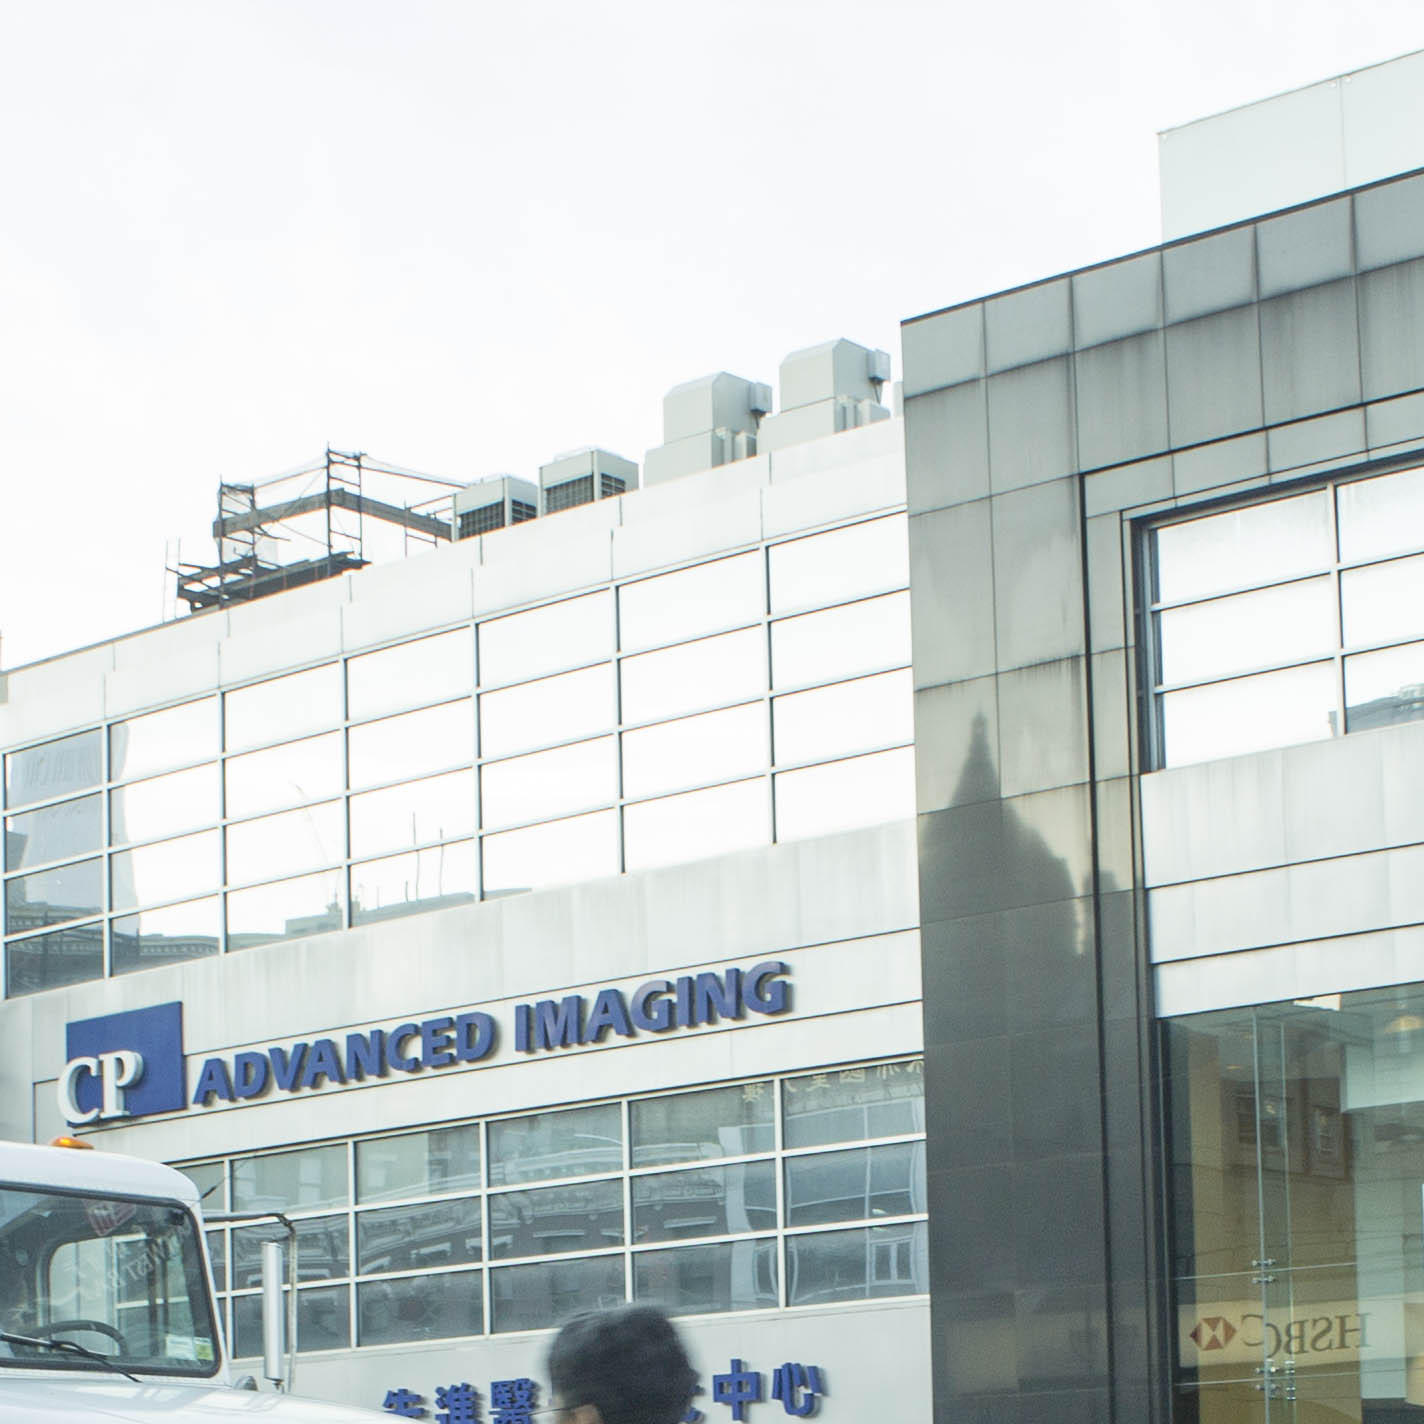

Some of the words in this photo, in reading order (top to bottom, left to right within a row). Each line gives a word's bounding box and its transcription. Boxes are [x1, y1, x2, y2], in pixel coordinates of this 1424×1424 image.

[56, 1049, 144, 1124] CP
[191, 1011, 496, 1106] ADVANCED
[514, 961, 789, 1053] IMAGING
